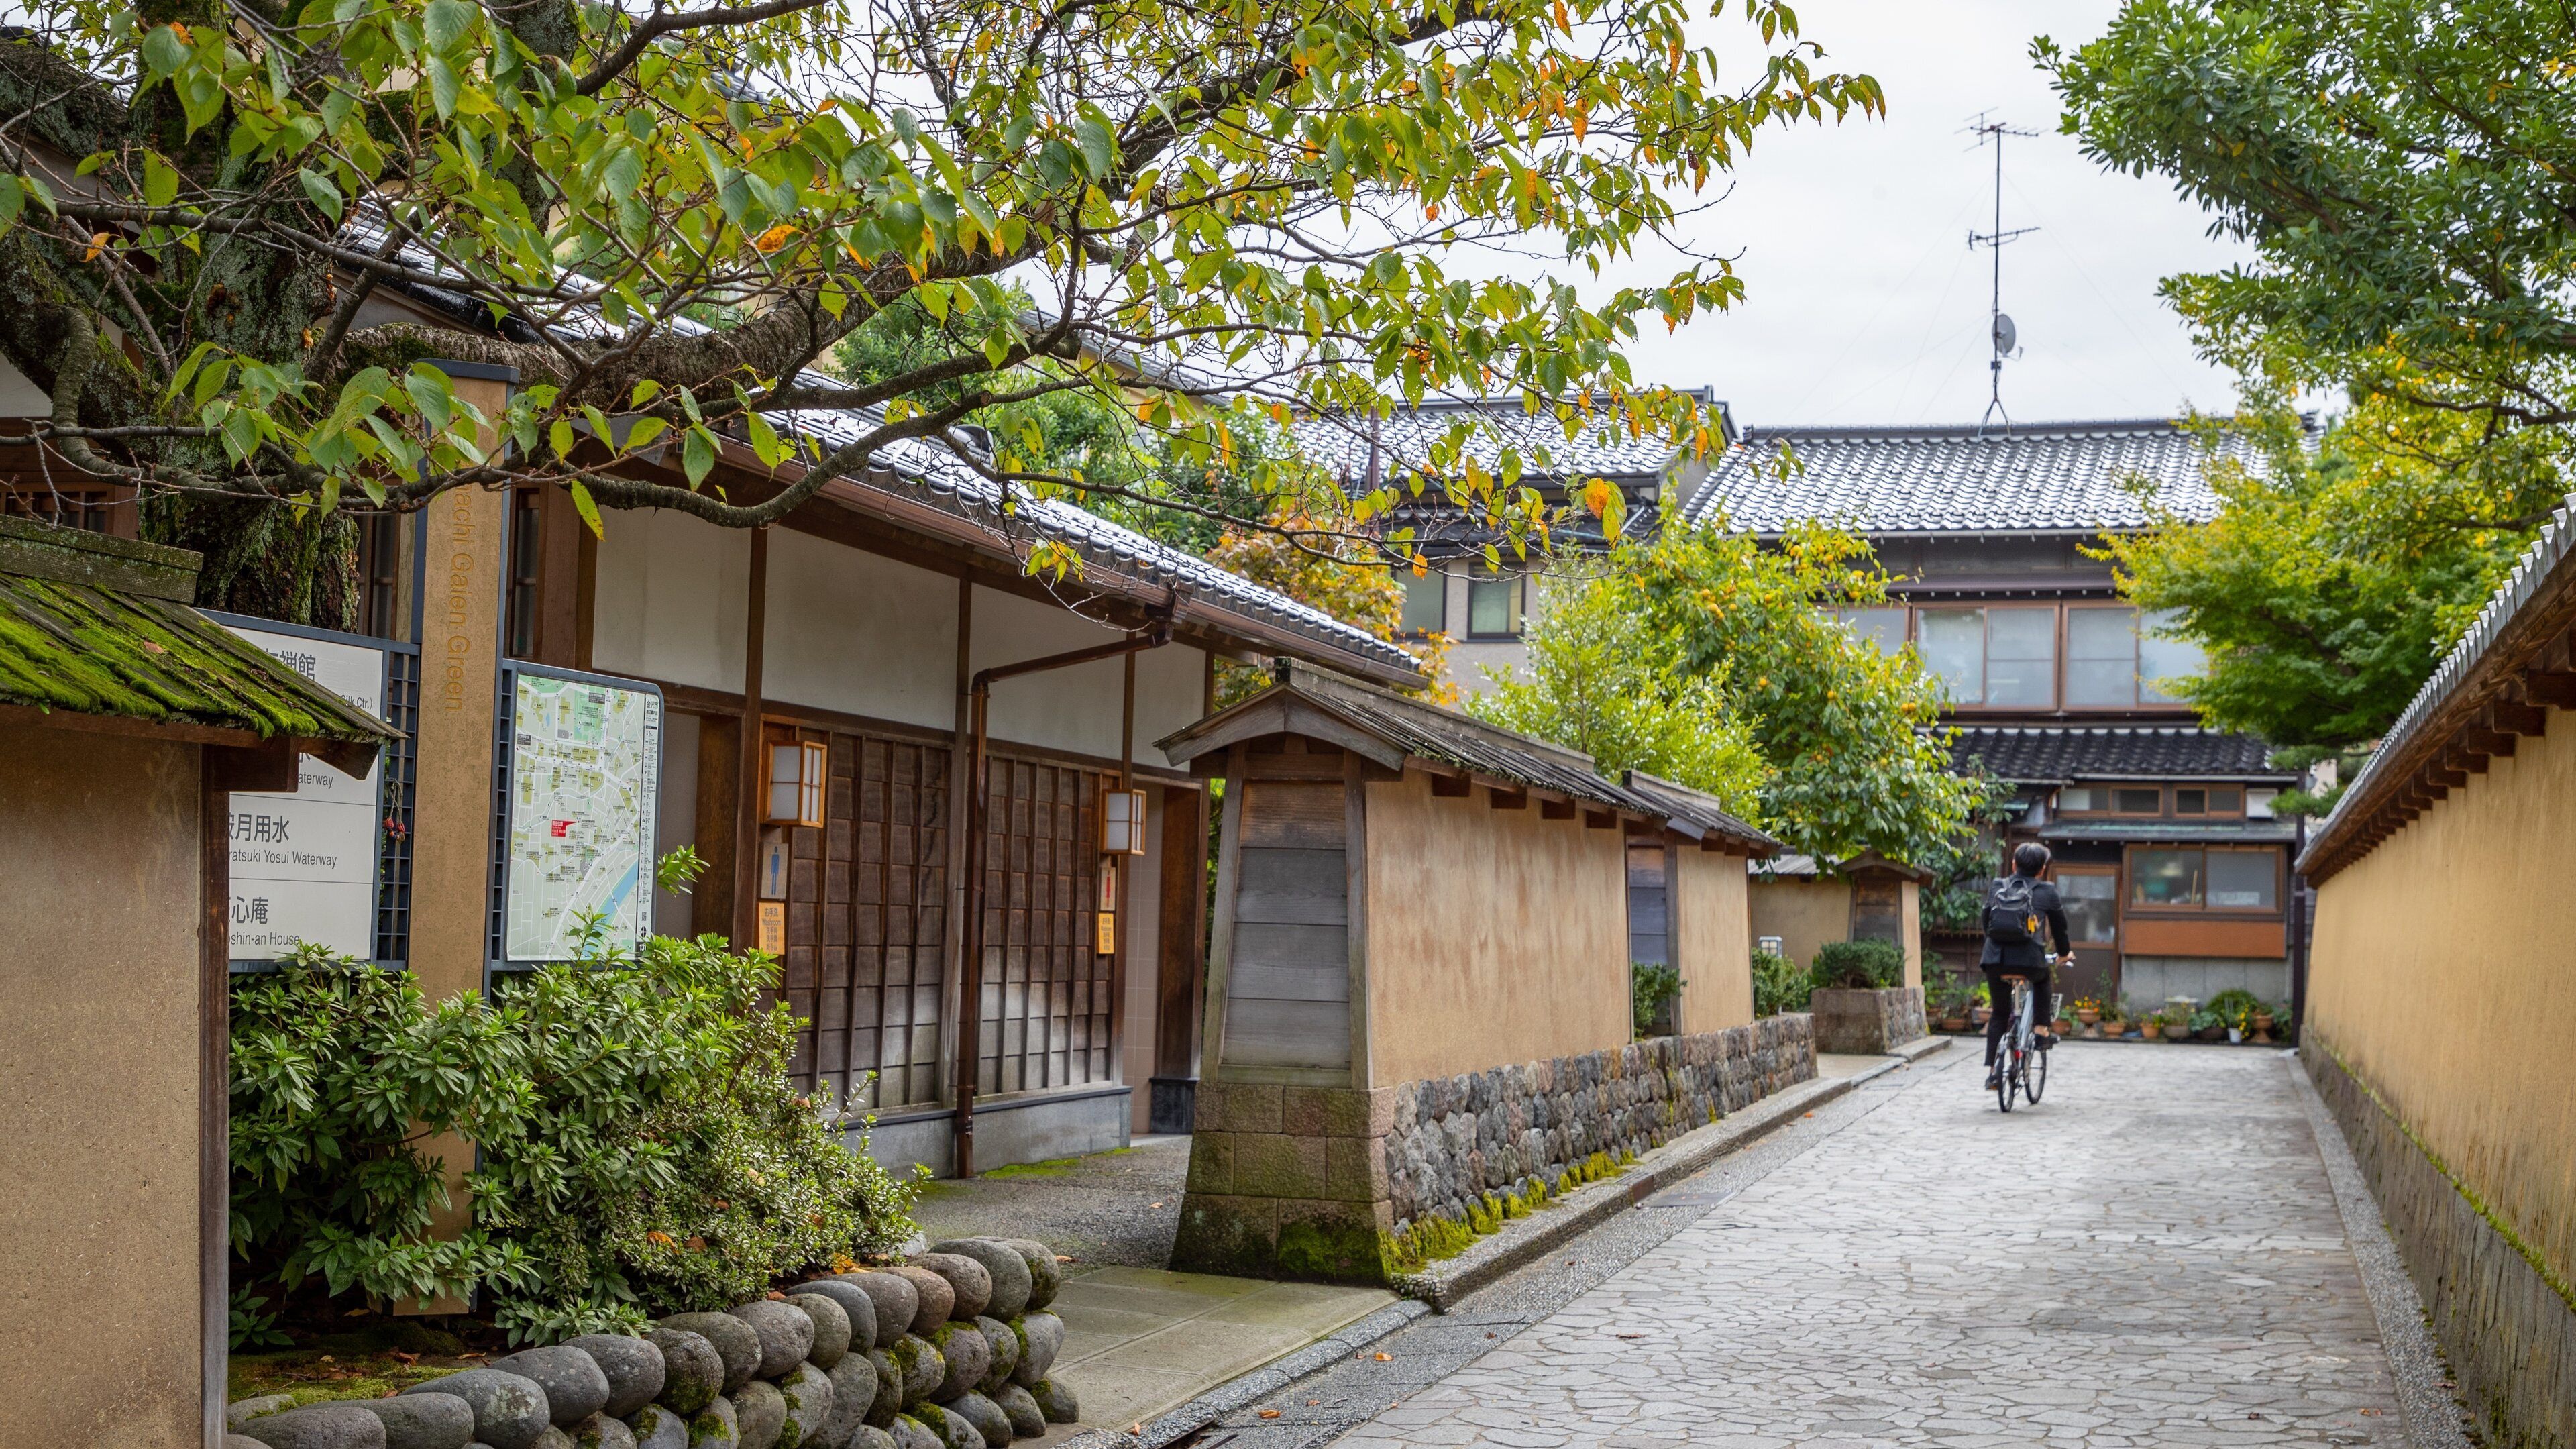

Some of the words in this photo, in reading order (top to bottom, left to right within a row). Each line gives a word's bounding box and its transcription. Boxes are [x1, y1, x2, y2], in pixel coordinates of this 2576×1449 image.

[449, 553, 474, 626] Gaien
[445, 635, 470, 712] Green
[298, 772, 333, 789] aterway
[264, 849, 289, 864] Yosui
[292, 851, 337, 869] Waterway
[229, 896, 268, 924] 心庵
[229, 931, 266, 945] shin-an
[270, 932, 300, 945] House
